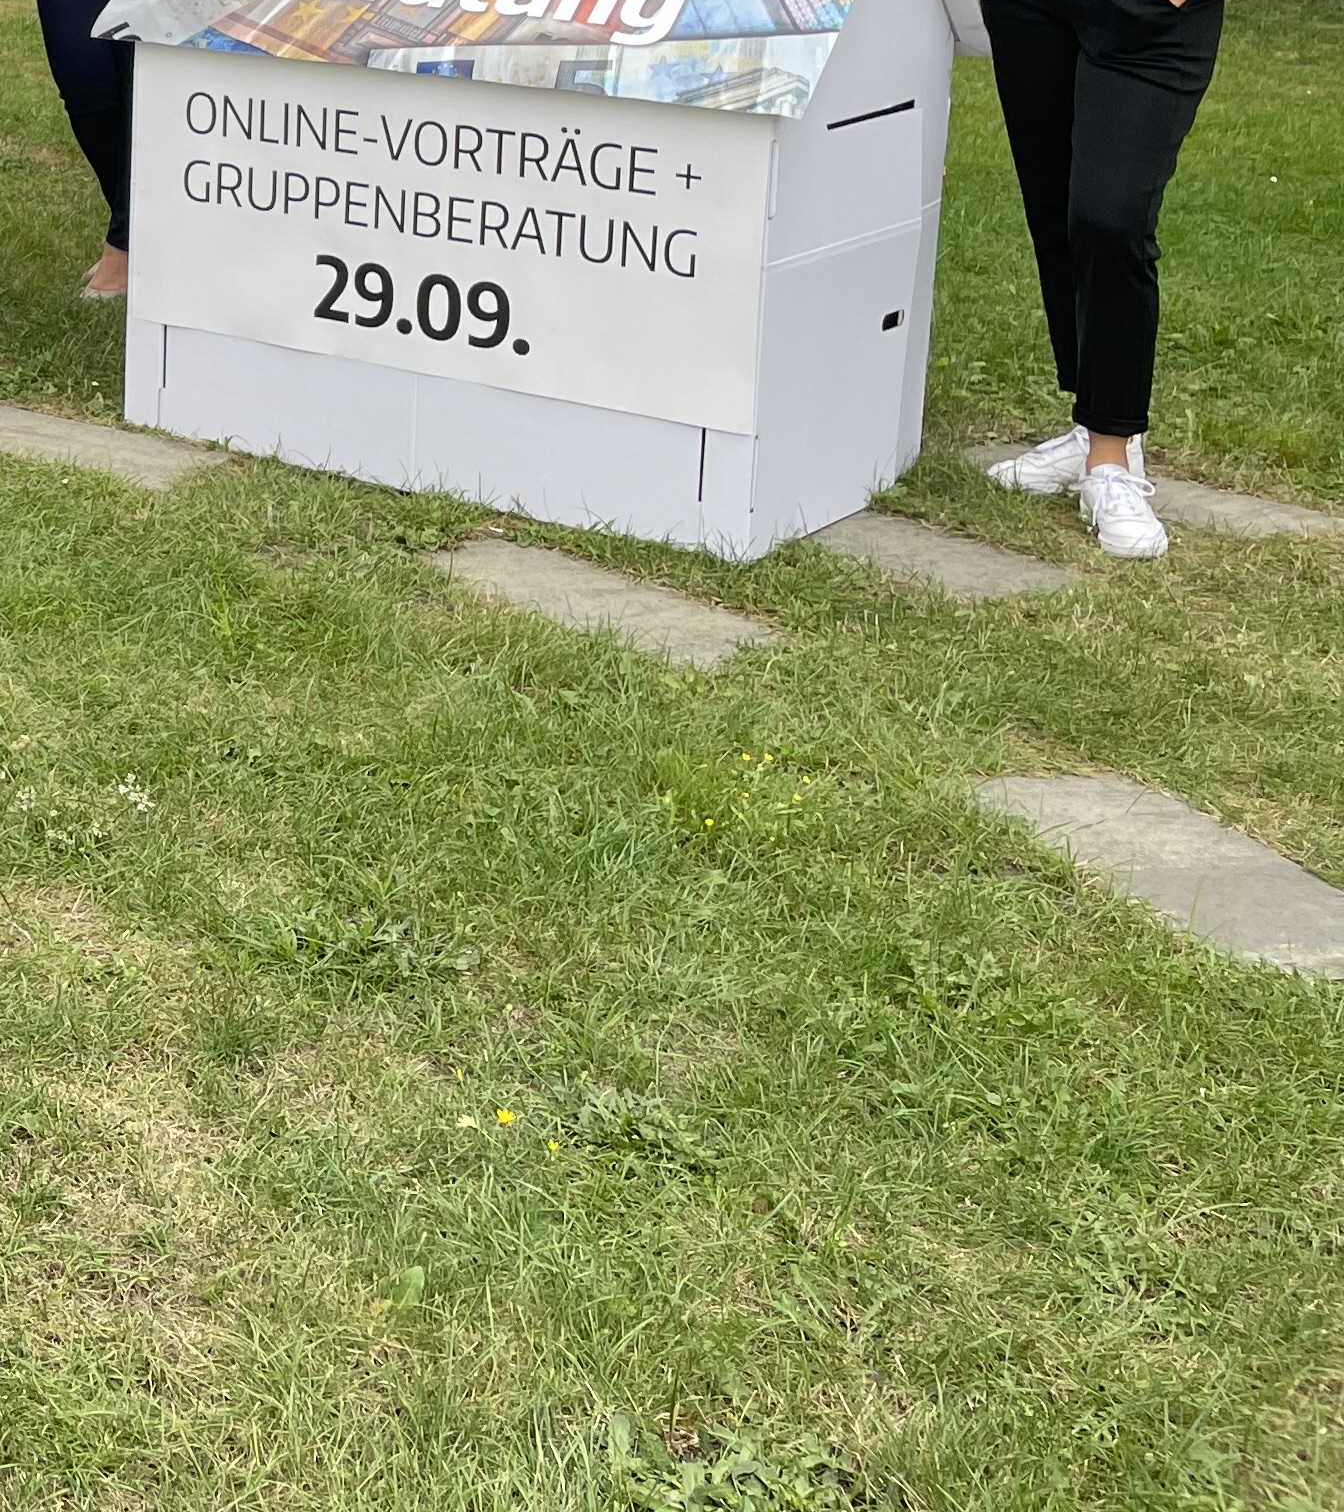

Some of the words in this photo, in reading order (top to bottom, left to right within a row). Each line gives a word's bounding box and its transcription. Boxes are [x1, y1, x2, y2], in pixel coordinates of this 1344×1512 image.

[185, 91, 659, 195] ONLINE-VORTRÄGE
[675, 164, 702, 190] +
[182, 160, 698, 278] GRUPPENBERATUNG
[313, 254, 532, 356] 29.09.
